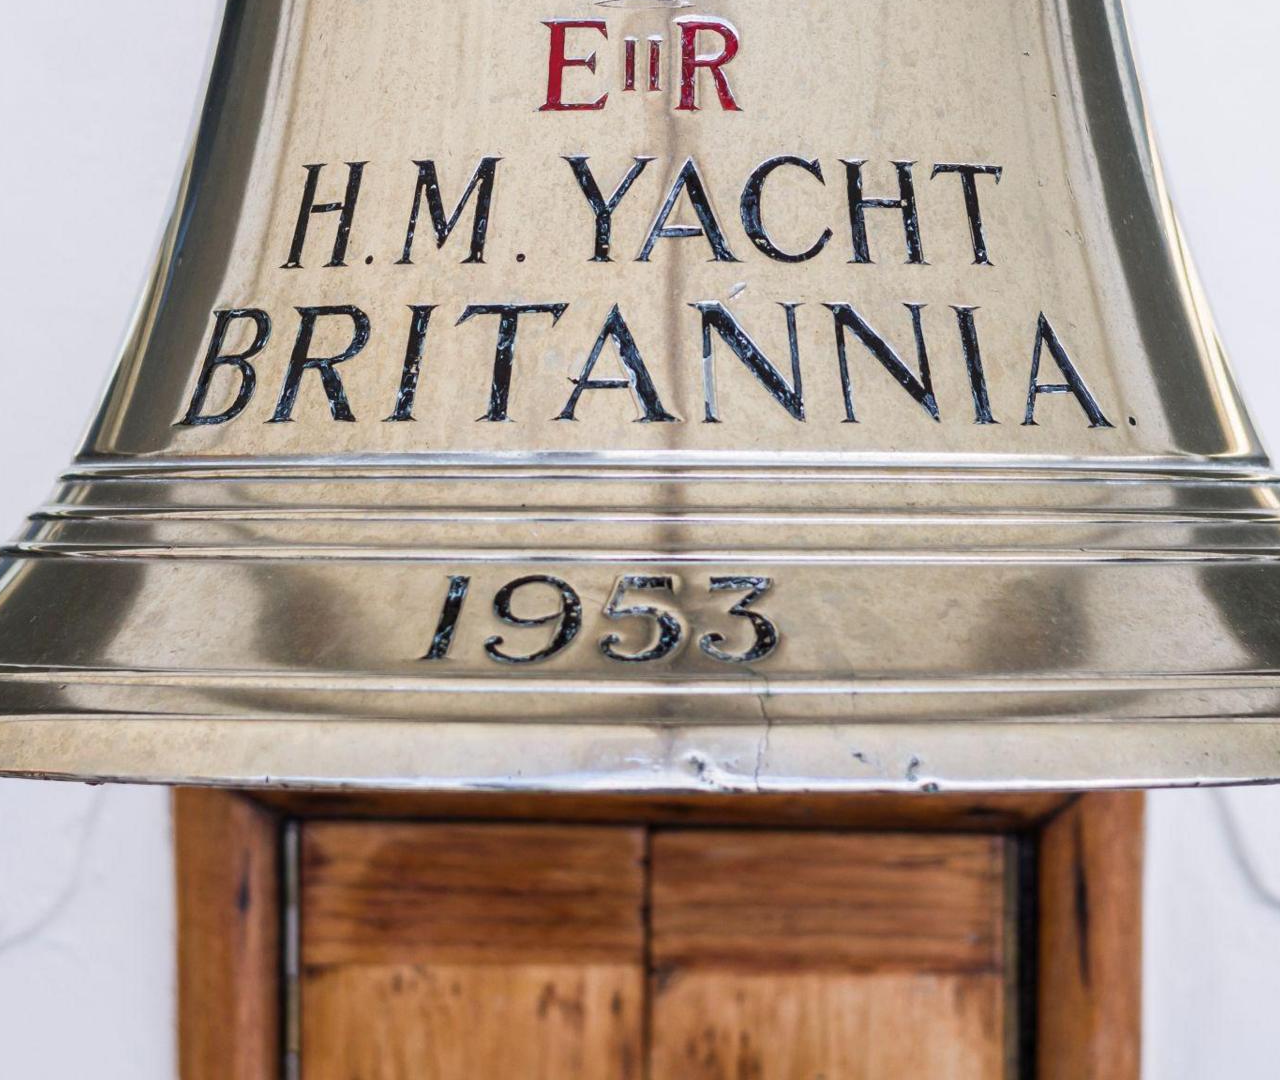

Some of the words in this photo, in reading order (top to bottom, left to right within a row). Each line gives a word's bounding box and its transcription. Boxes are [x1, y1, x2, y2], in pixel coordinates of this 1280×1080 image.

[279, 156, 527, 270] H.M.
[560, 154, 1004, 267] YACHT
[172, 301, 1140, 429] BRITANNIA.
[420, 574, 780, 665] 1953
